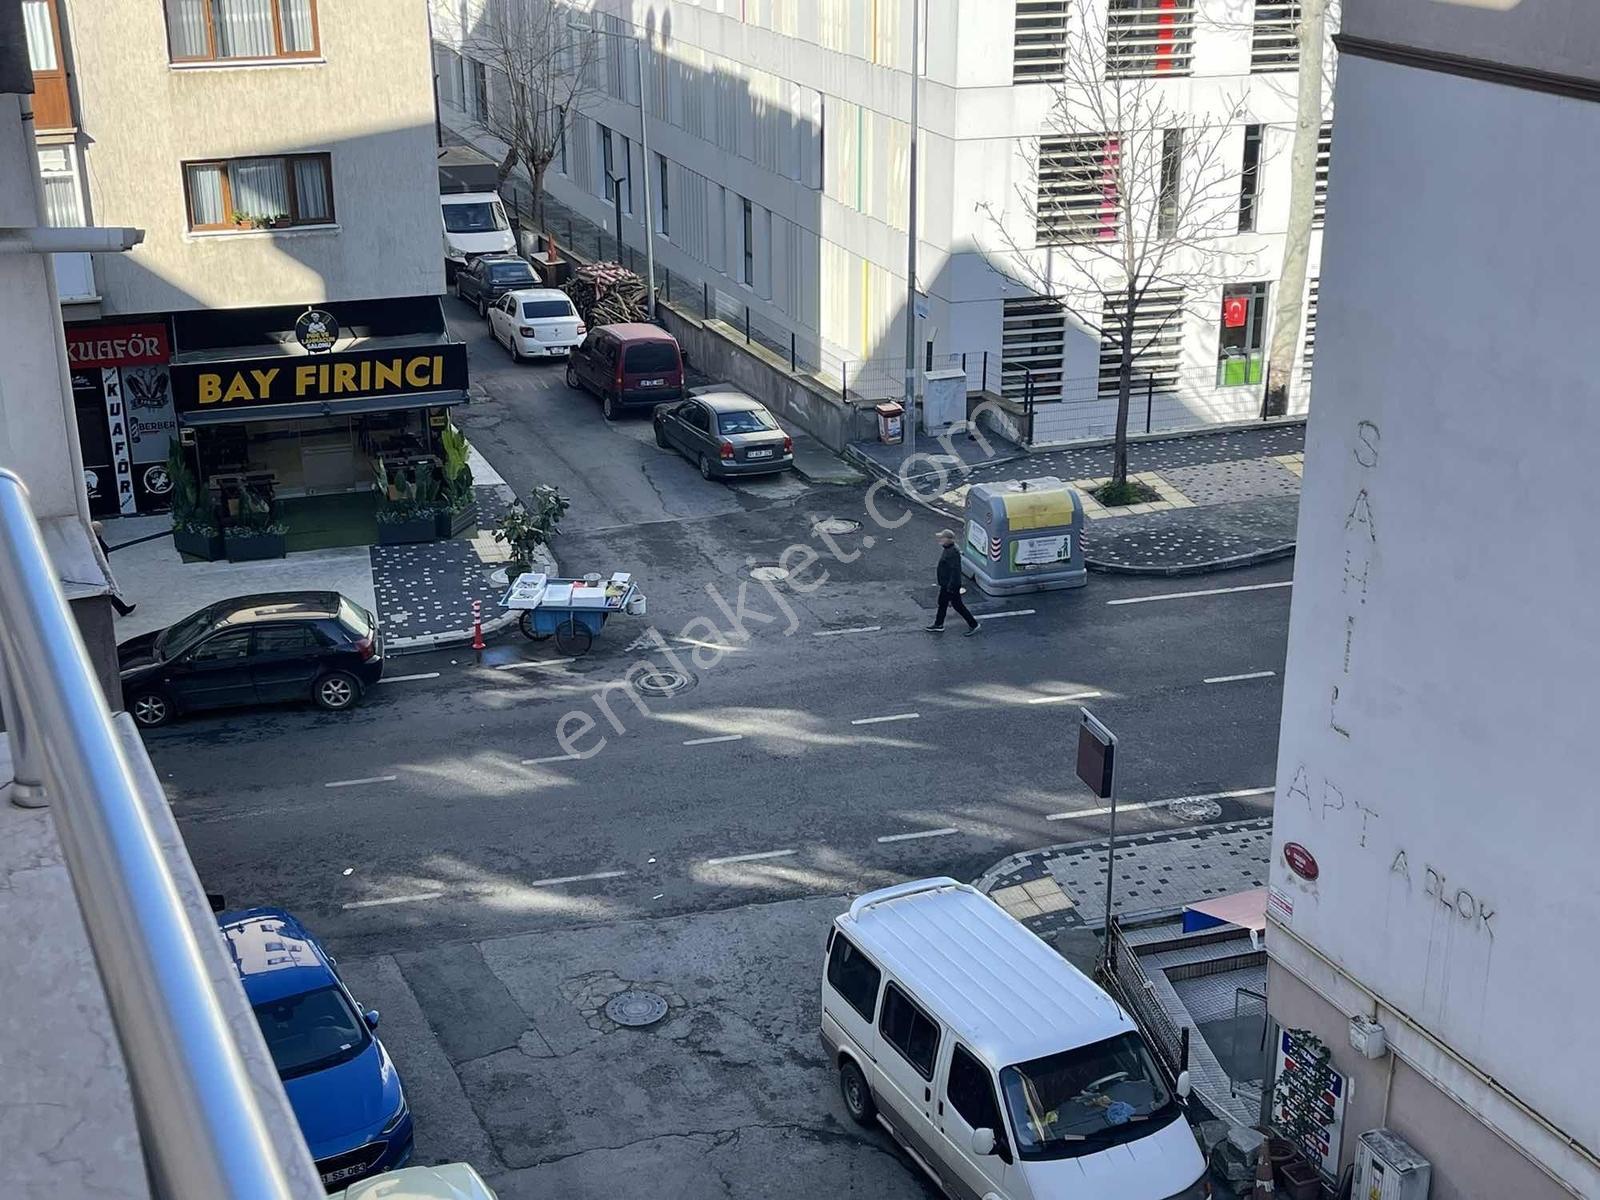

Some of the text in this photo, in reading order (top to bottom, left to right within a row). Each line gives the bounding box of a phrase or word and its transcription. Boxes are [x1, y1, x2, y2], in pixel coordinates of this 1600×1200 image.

[199, 356, 444, 404] BAY FIRINCI
[139, 420, 176, 431] BERBER
